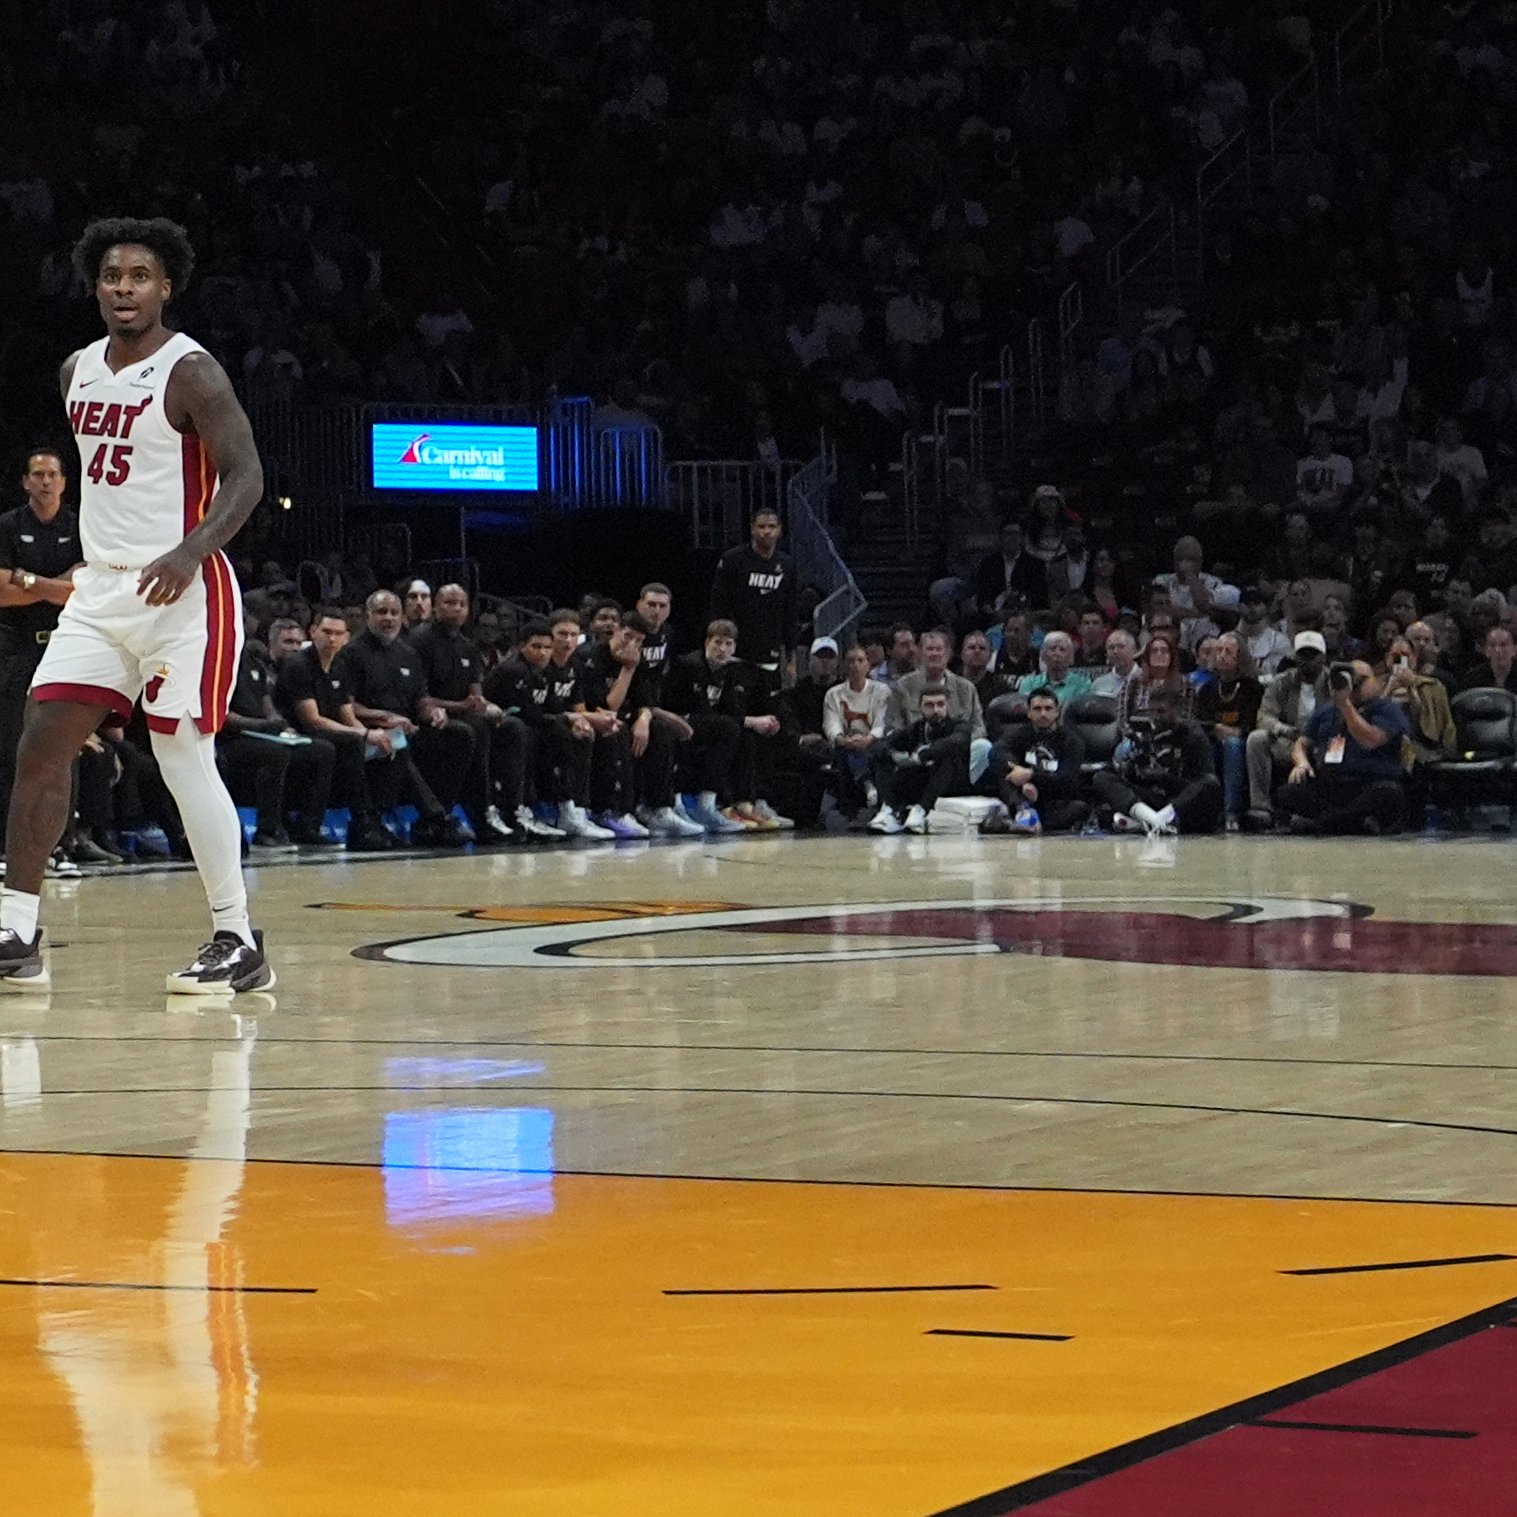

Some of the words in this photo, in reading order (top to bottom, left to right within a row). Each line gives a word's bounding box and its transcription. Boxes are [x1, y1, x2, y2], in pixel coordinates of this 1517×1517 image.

[69, 393, 153, 439] HEAT
[87, 443, 133, 487] 45
[422, 445, 504, 466] Carnival
[748, 571, 784, 590] HEAT
